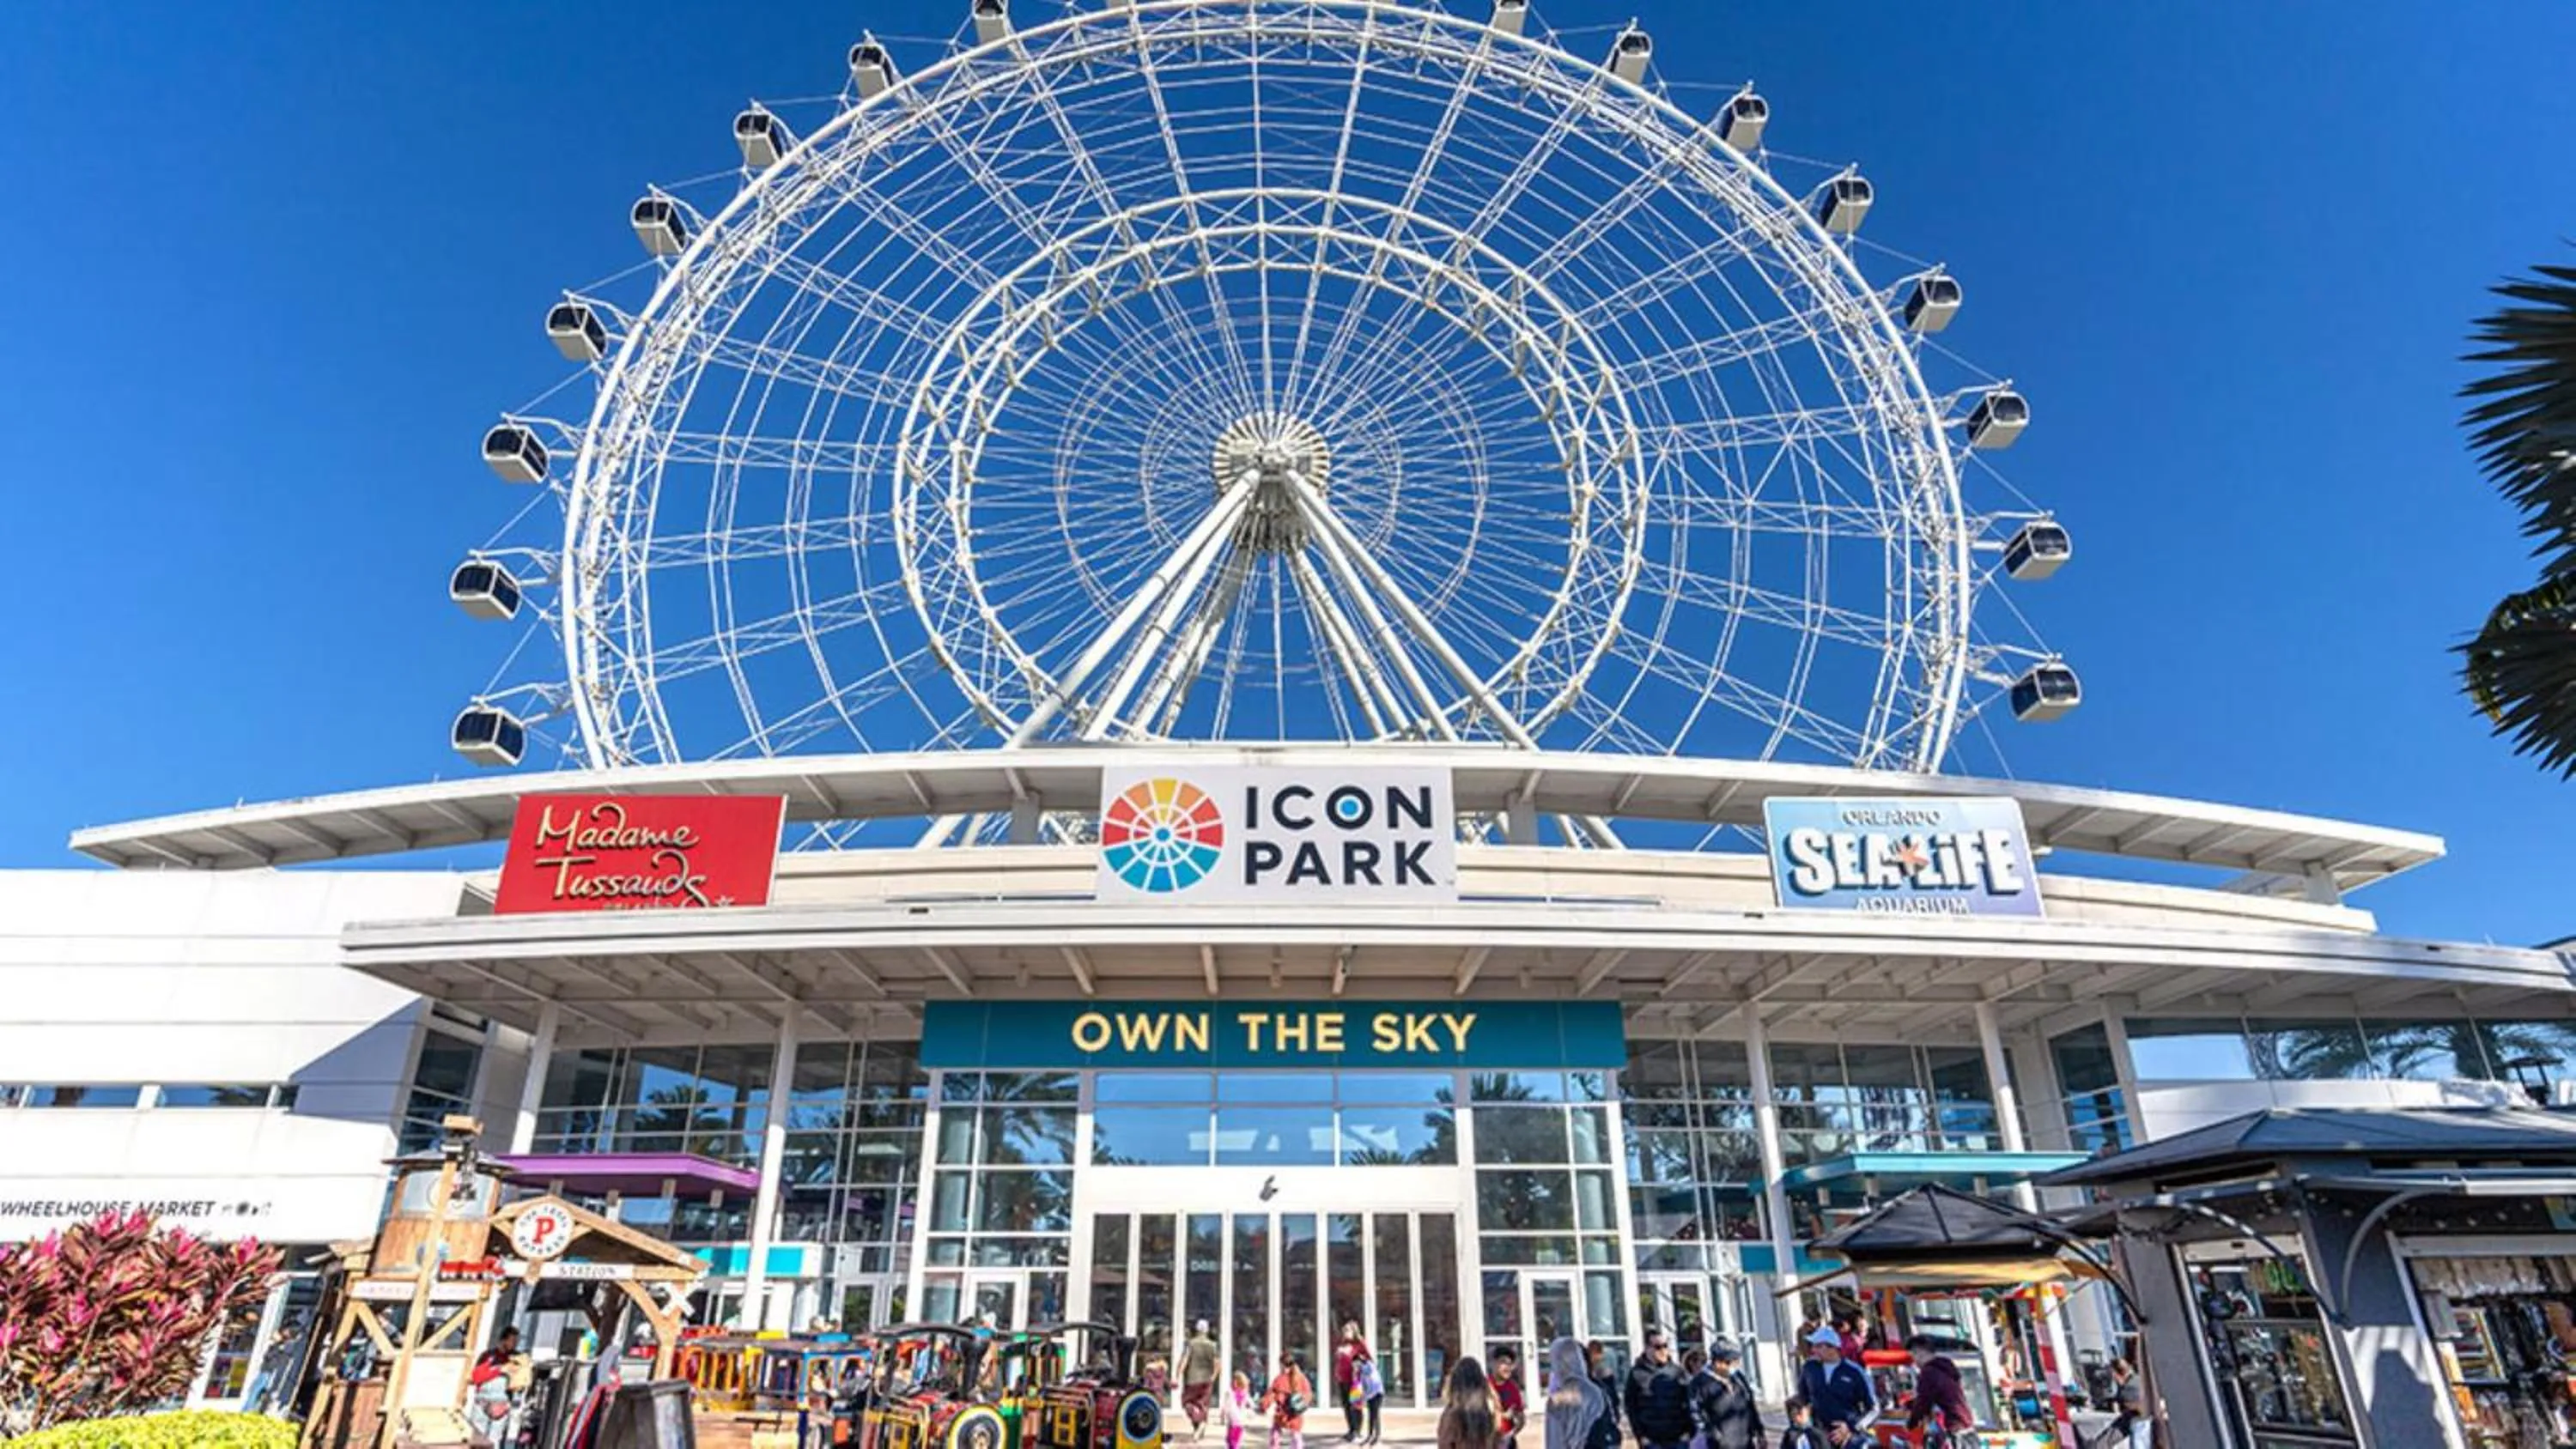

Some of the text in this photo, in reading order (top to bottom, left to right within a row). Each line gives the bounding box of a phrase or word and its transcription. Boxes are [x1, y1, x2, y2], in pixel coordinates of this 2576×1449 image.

[535, 803, 699, 853] Madame
[1246, 785, 1433, 831] ICON
[1842, 809, 1941, 828] ORLANDO
[535, 848, 711, 907] Tussauds
[1244, 840, 1437, 886] PARK
[1783, 828, 1902, 896] SEA
[1856, 896, 1970, 915] AQUARIUM
[1072, 1012, 1477, 1052] OWN THE SKY
[1, 1201, 131, 1217] WHEELHOUSE
[532, 1215, 556, 1245] P
